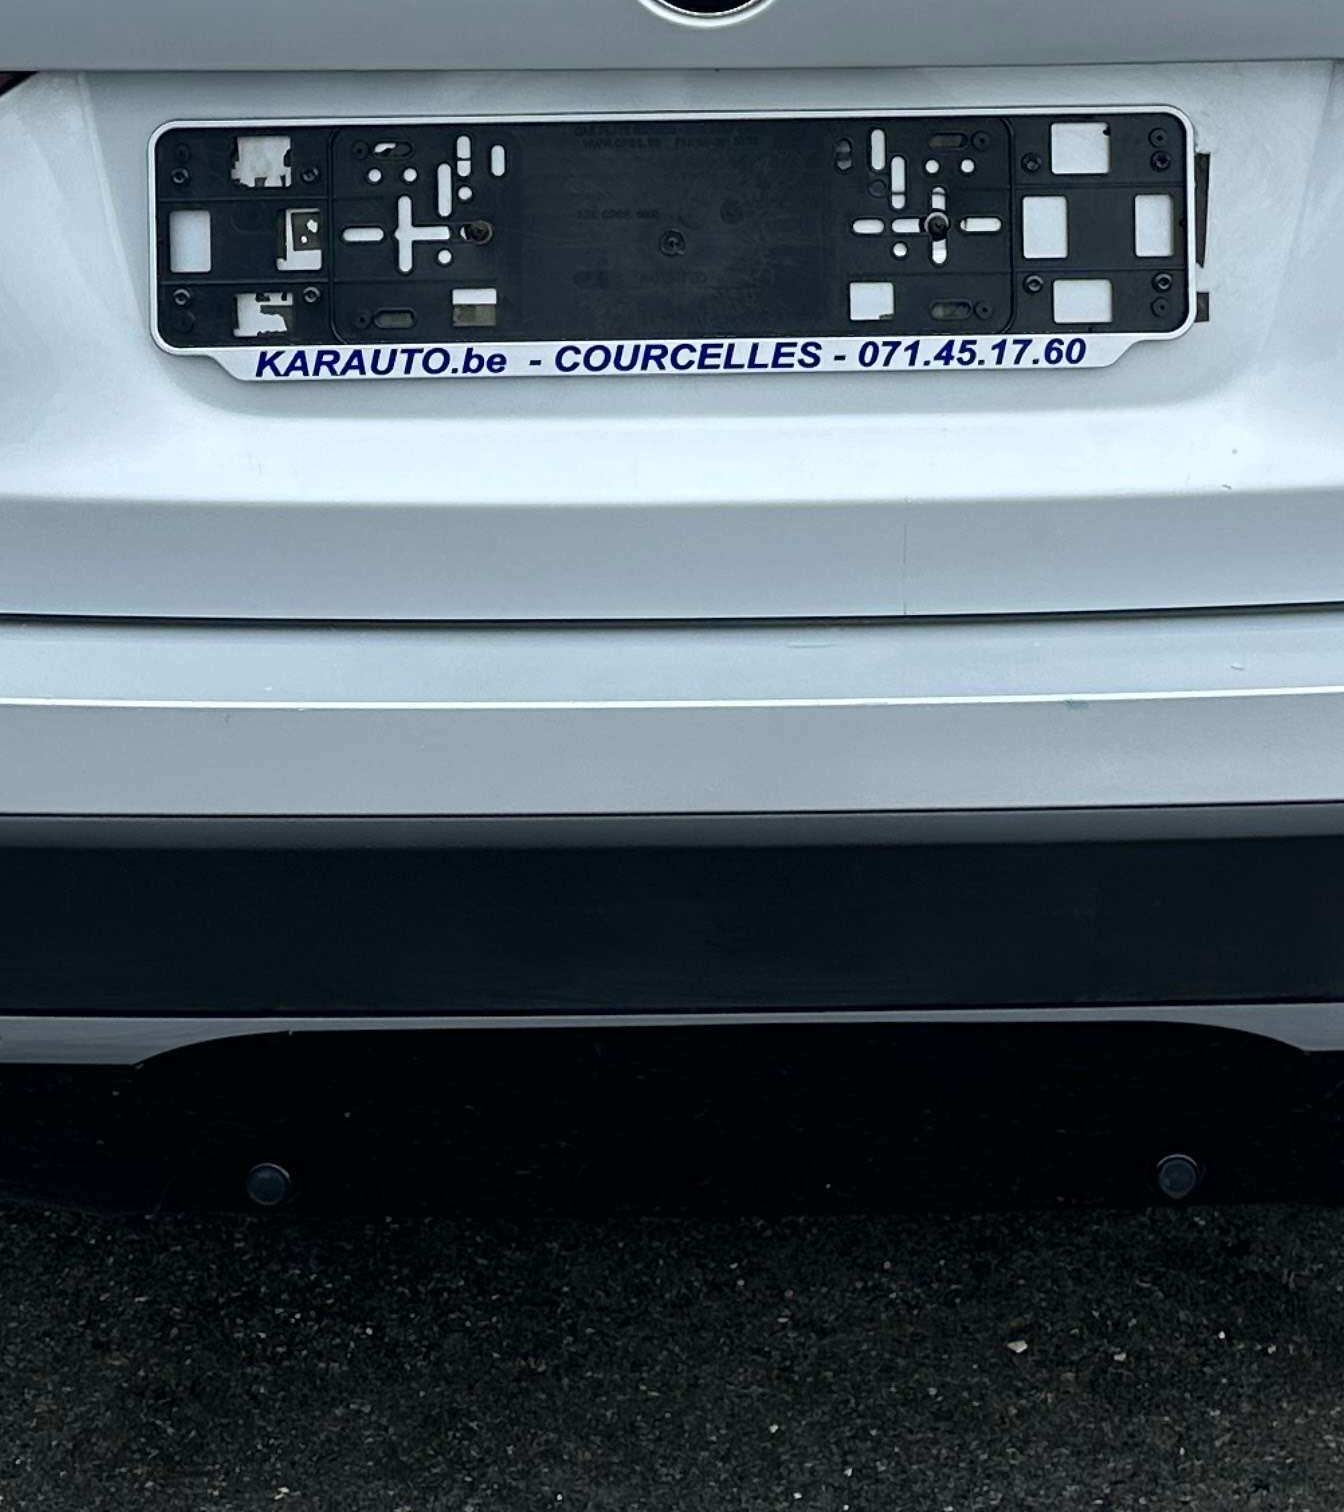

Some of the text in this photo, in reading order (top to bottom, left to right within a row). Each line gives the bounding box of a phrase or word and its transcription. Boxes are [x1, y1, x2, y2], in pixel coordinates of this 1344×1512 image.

[256, 347, 508, 377] KARAUTO.be
[555, 342, 822, 372] COURCELLES
[858, 338, 1087, 368] 071.45.17.60
